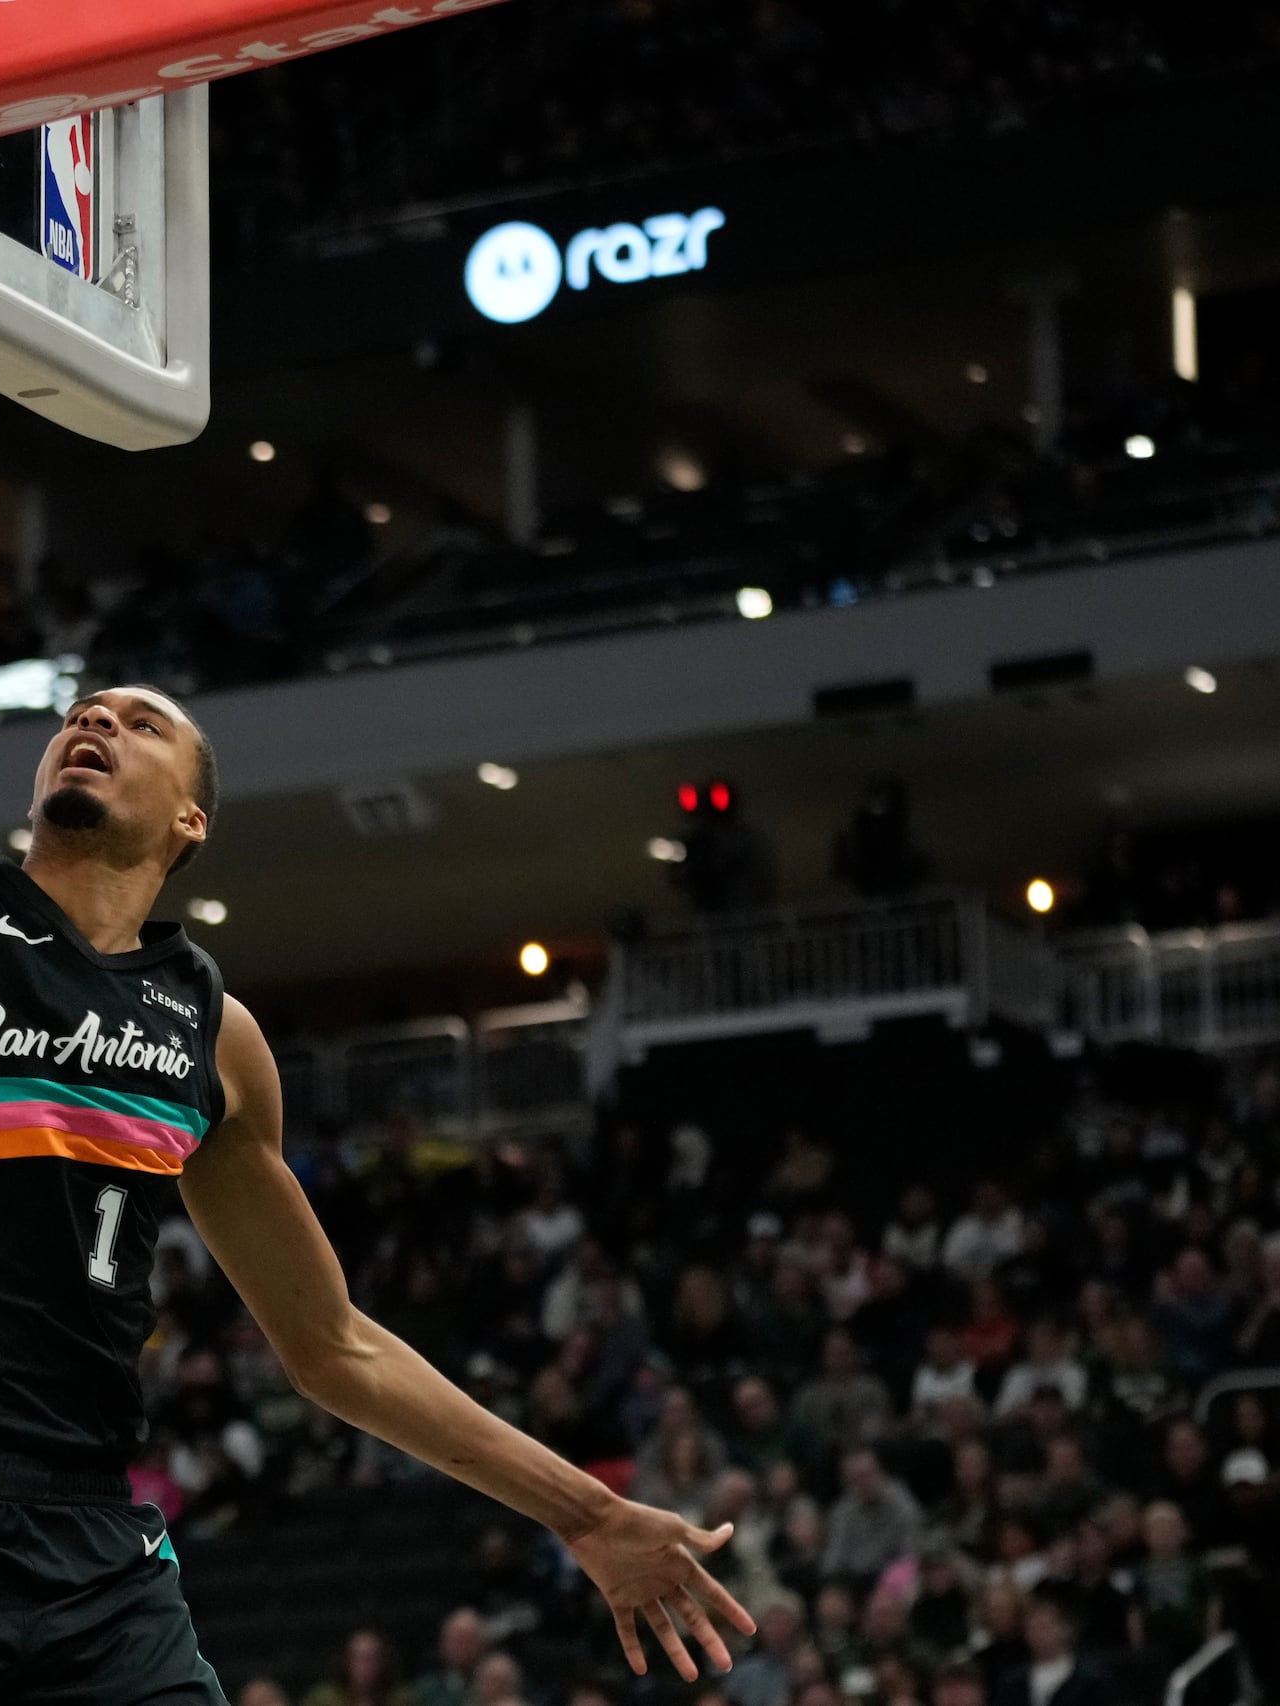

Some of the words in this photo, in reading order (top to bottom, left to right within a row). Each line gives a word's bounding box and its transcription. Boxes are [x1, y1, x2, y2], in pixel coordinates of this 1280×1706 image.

[49, 218, 74, 266] NBA
[565, 206, 726, 290] razr
[150, 988, 192, 1019] LEDGER
[53, 1010, 195, 1080] Antonio
[88, 1184, 129, 1289] 1
